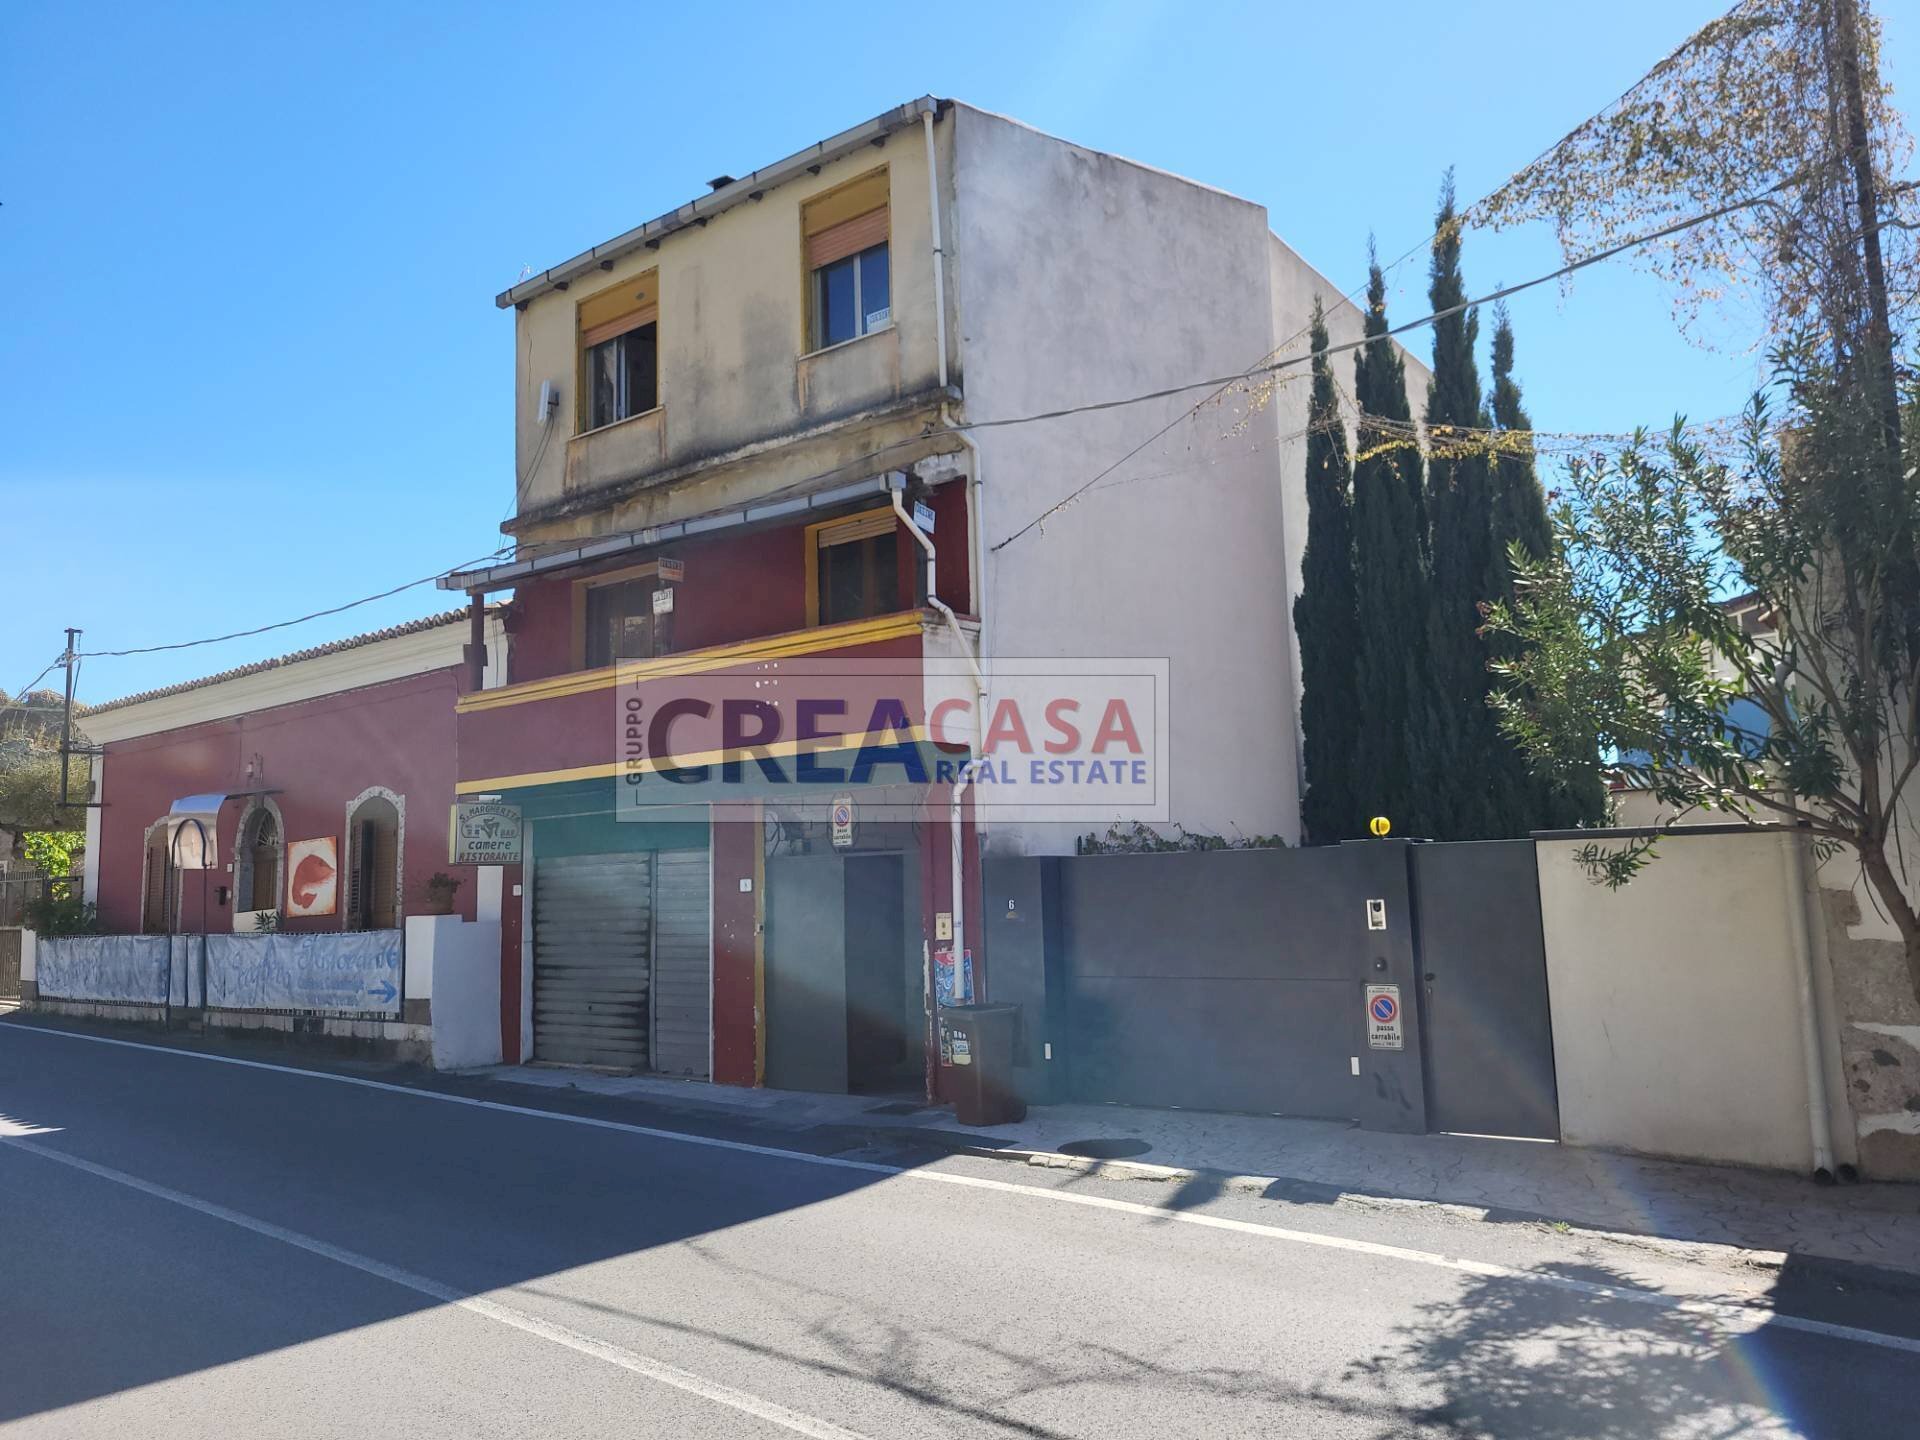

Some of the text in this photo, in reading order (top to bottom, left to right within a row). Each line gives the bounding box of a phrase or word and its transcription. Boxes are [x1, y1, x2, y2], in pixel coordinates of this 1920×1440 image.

[468, 841, 512, 850] camere
[458, 852, 520, 862] RISTORANTE
[1008, 899, 1015, 910] 6
[1371, 1033, 1400, 1041] carrabile
